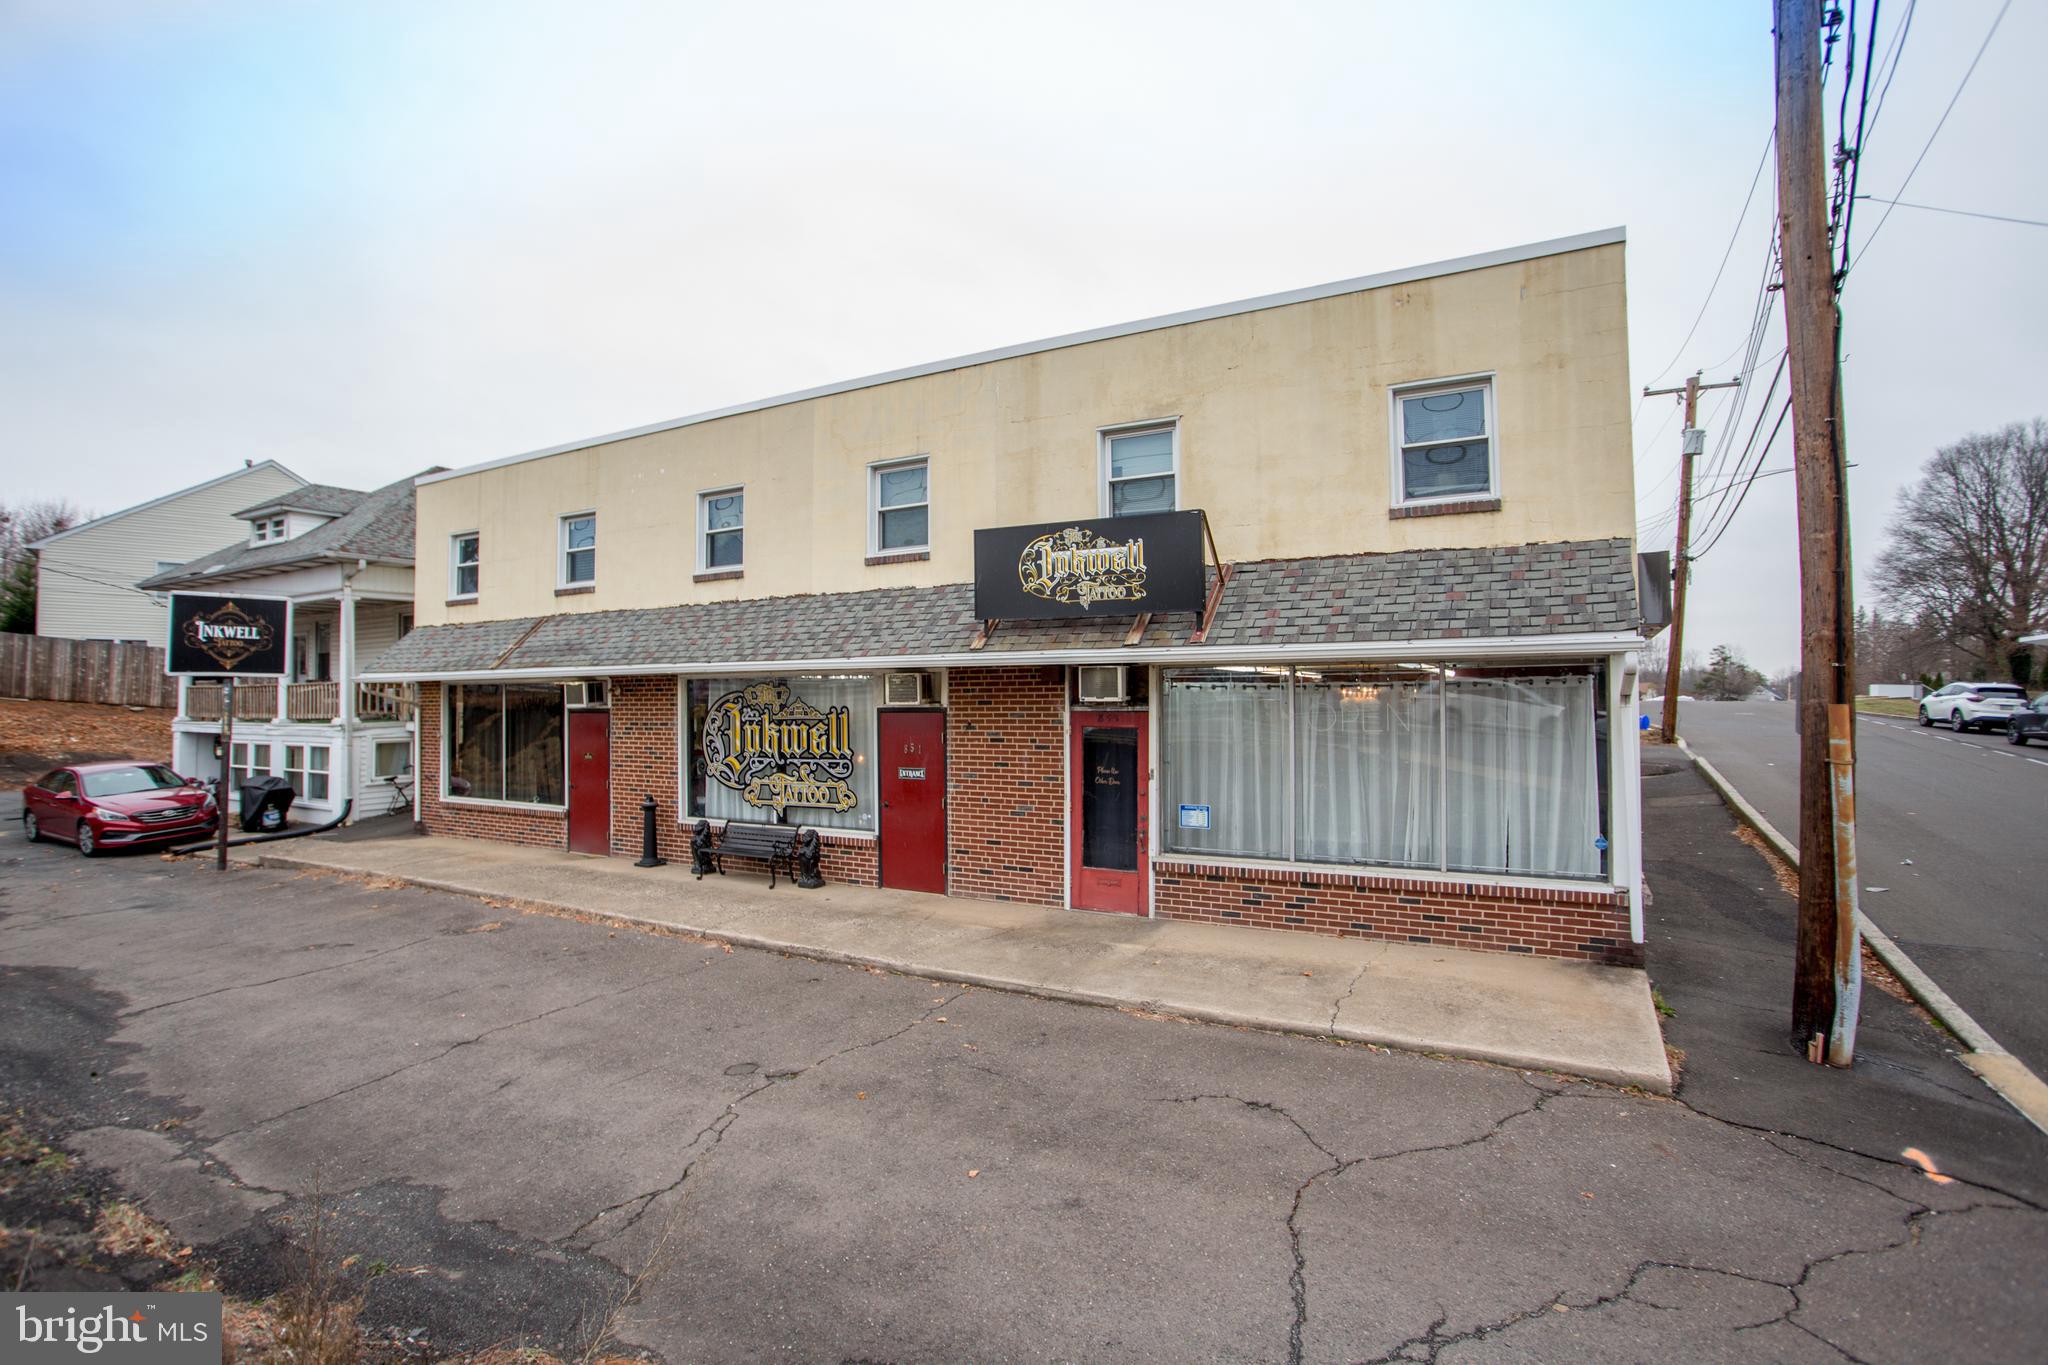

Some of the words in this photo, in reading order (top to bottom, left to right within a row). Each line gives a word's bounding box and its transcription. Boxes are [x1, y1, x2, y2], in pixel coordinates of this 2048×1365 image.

[1031, 538, 1147, 595] Inkwell
[719, 703, 854, 777] Inkwell
[1307, 700, 1410, 732] OPEN
